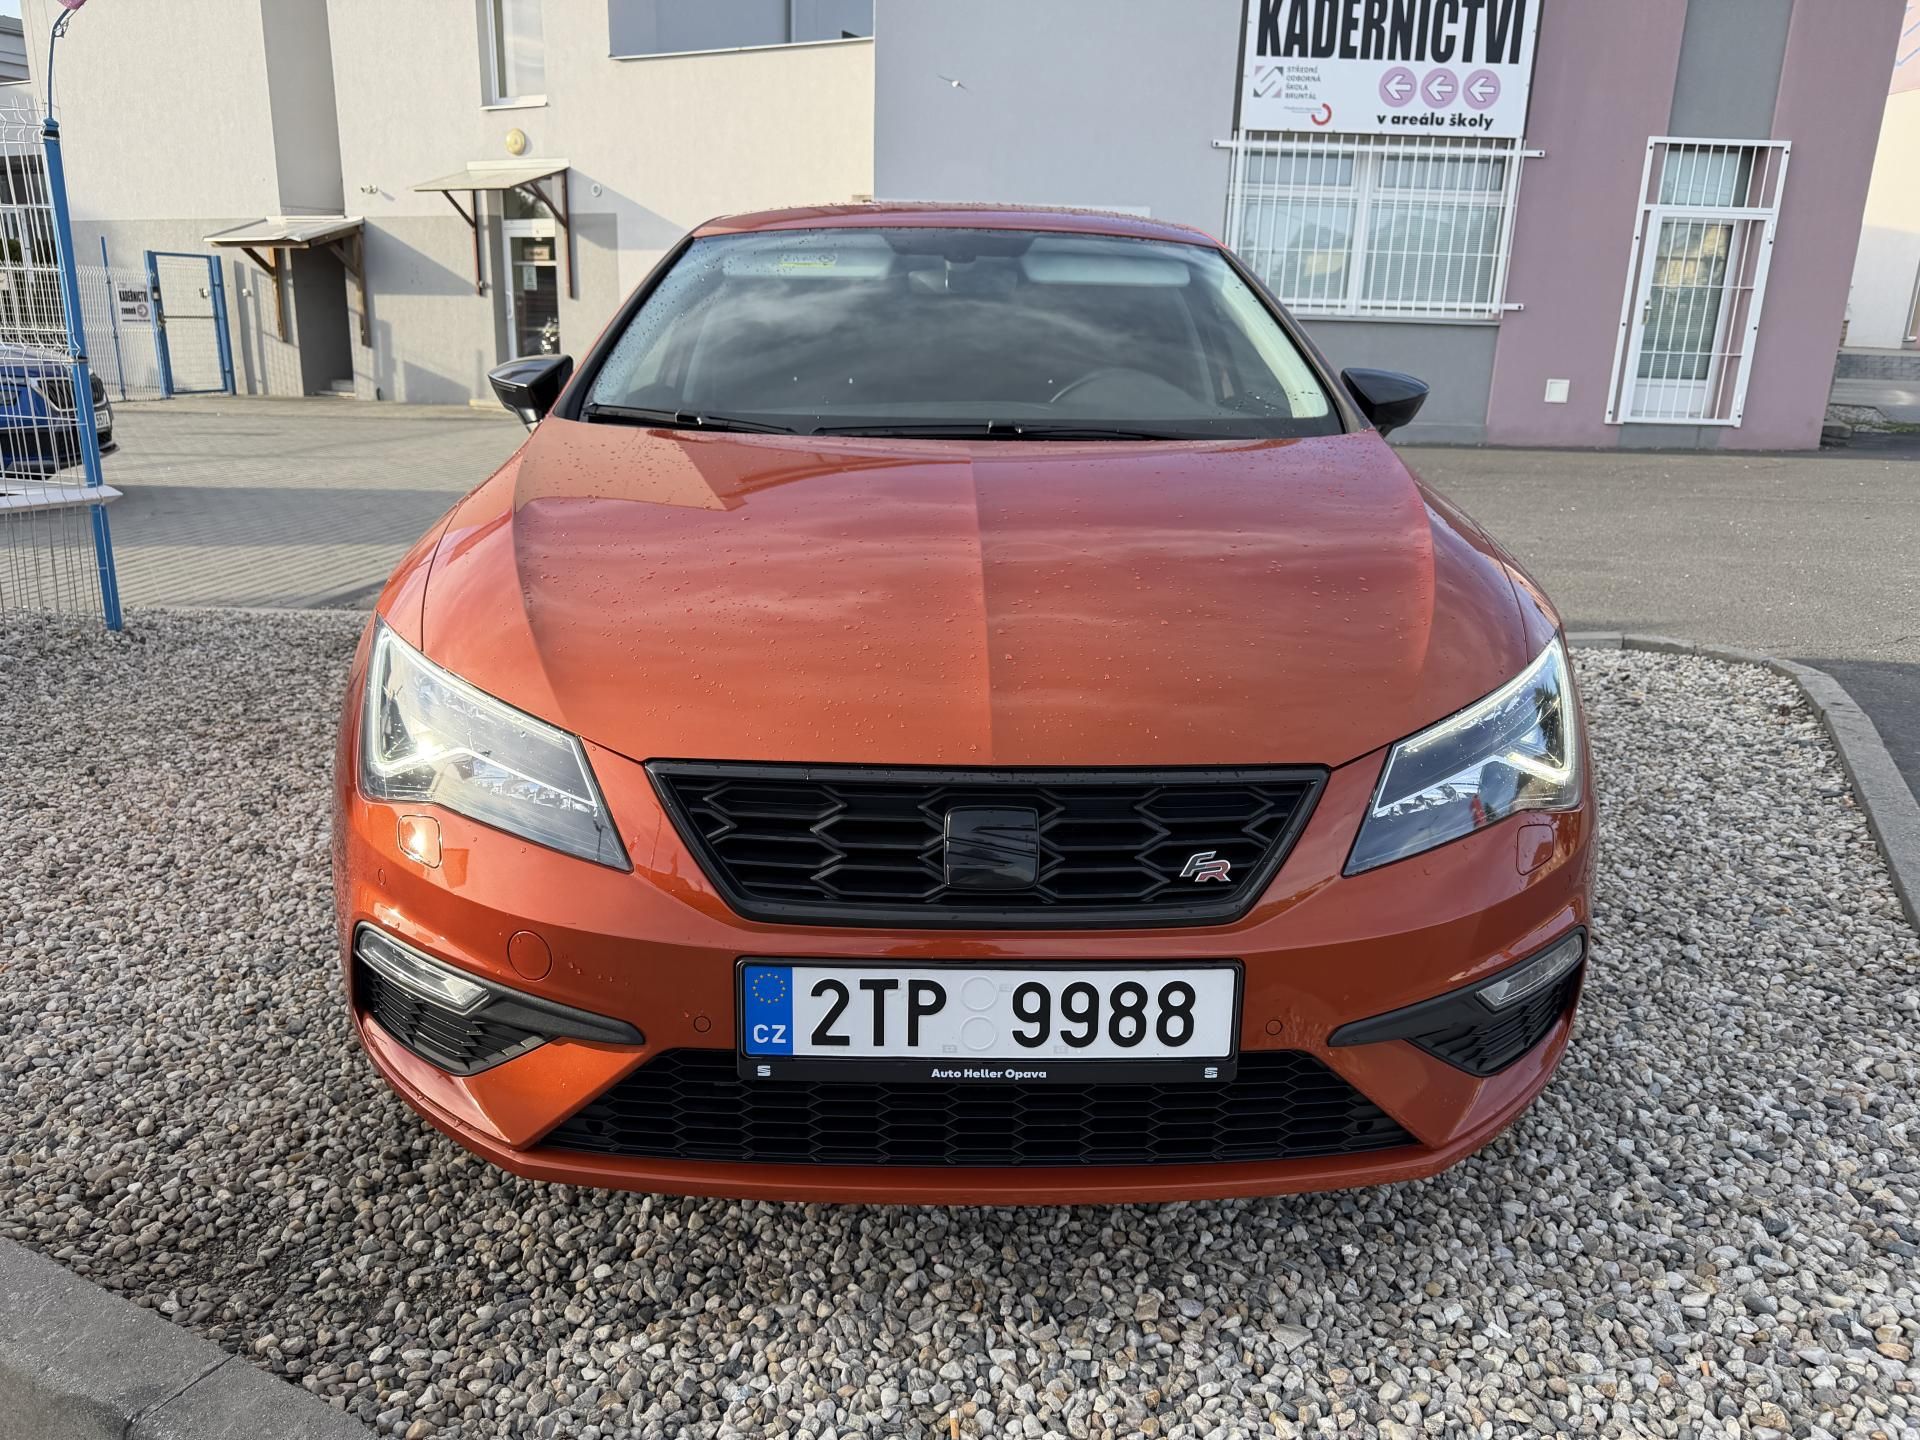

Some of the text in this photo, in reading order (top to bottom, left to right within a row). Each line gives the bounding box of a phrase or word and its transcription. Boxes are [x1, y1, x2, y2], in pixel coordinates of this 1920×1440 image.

[1285, 83, 1308, 91] ŠKOLA
[1286, 74, 1321, 82] ODBORNÁ
[1377, 112, 1494, 131] v areálu školy
[1179, 850, 1232, 882] FR
[810, 978, 1196, 1048] 2TP 9988
[753, 1024, 787, 1044] CZ
[931, 1068, 1047, 1080] Auto Heller Opava
